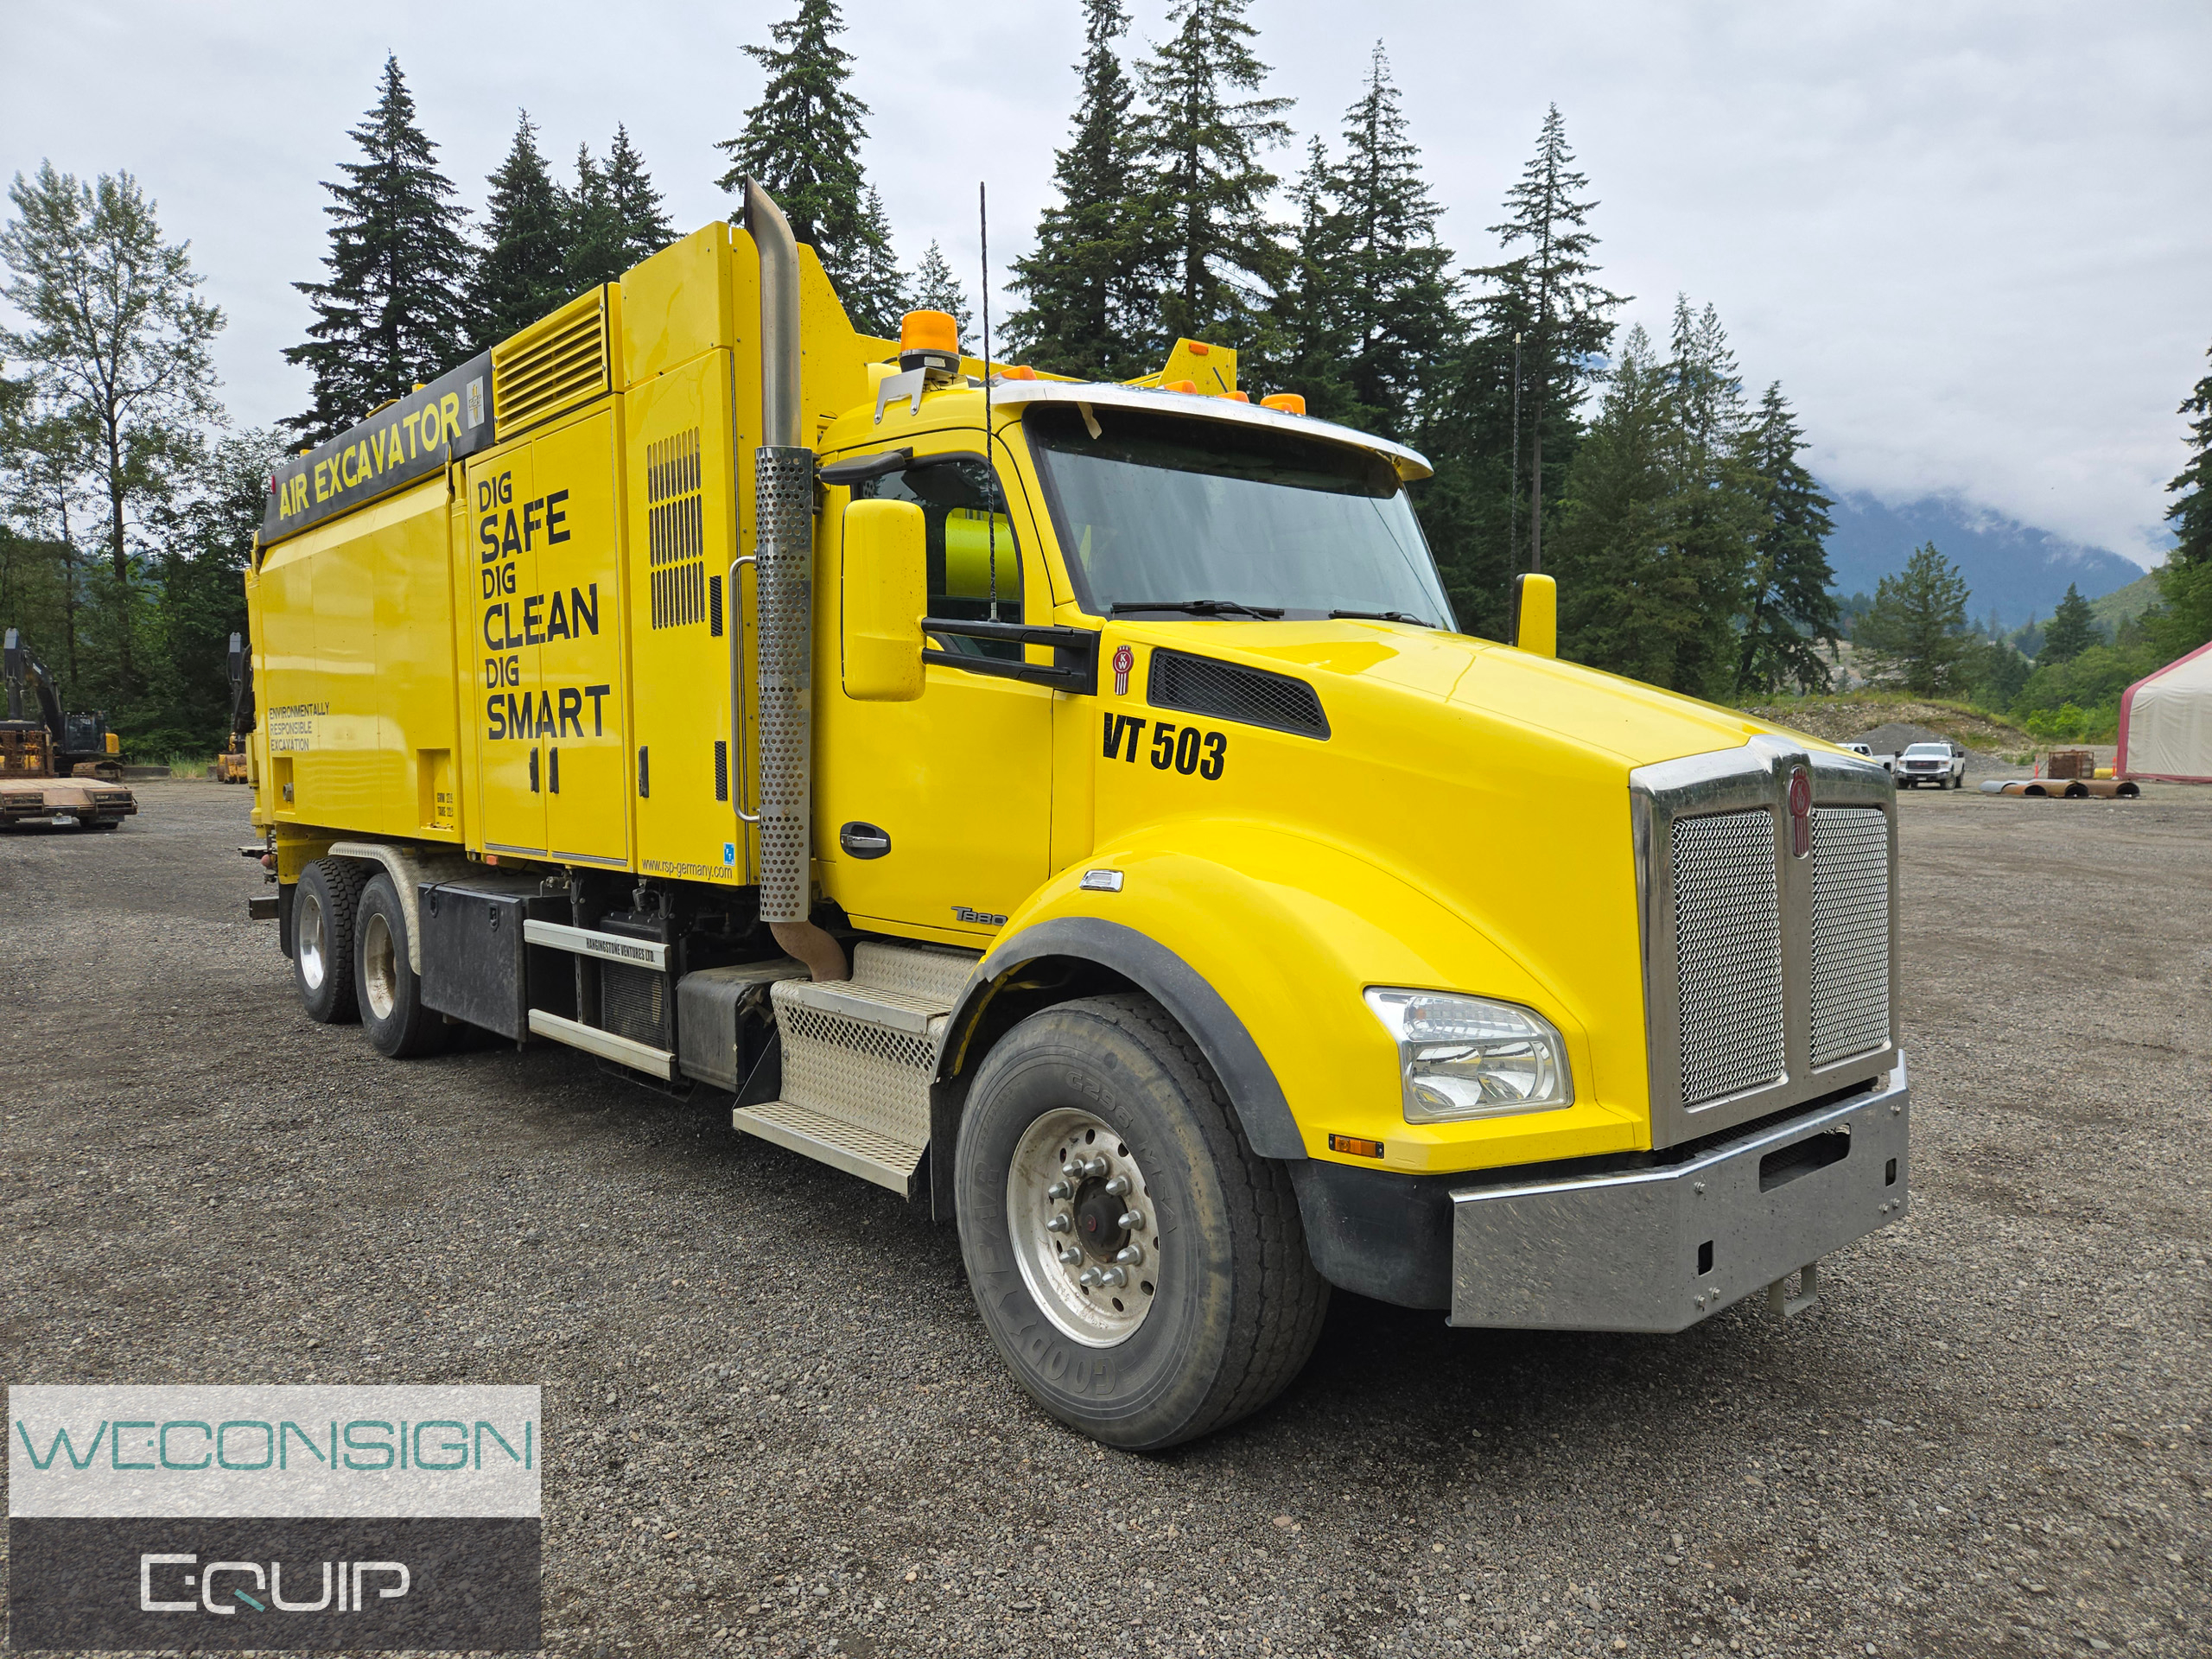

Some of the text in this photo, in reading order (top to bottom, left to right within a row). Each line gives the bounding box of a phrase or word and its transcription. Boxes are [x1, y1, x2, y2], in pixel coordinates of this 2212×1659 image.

[280, 392, 461, 520] AIR EXCAVATOR
[478, 470, 512, 512] DIG
[480, 489, 570, 564] SAFE
[482, 562, 516, 600] DIG
[484, 583, 599, 651] CLEAN
[486, 655, 519, 689] DIG
[269, 702, 330, 720] ENVIRONMENTALLY
[270, 721, 312, 736] RESPONSIBLE
[487, 684, 610, 740] SMART
[270, 738, 309, 752] EXCAVATION
[1103, 712, 1227, 781] VT 503
[641, 858, 733, 880] www.rsp-germany.com
[950, 906, 1008, 926] T880
[620, 944, 645, 961] VENTURES
